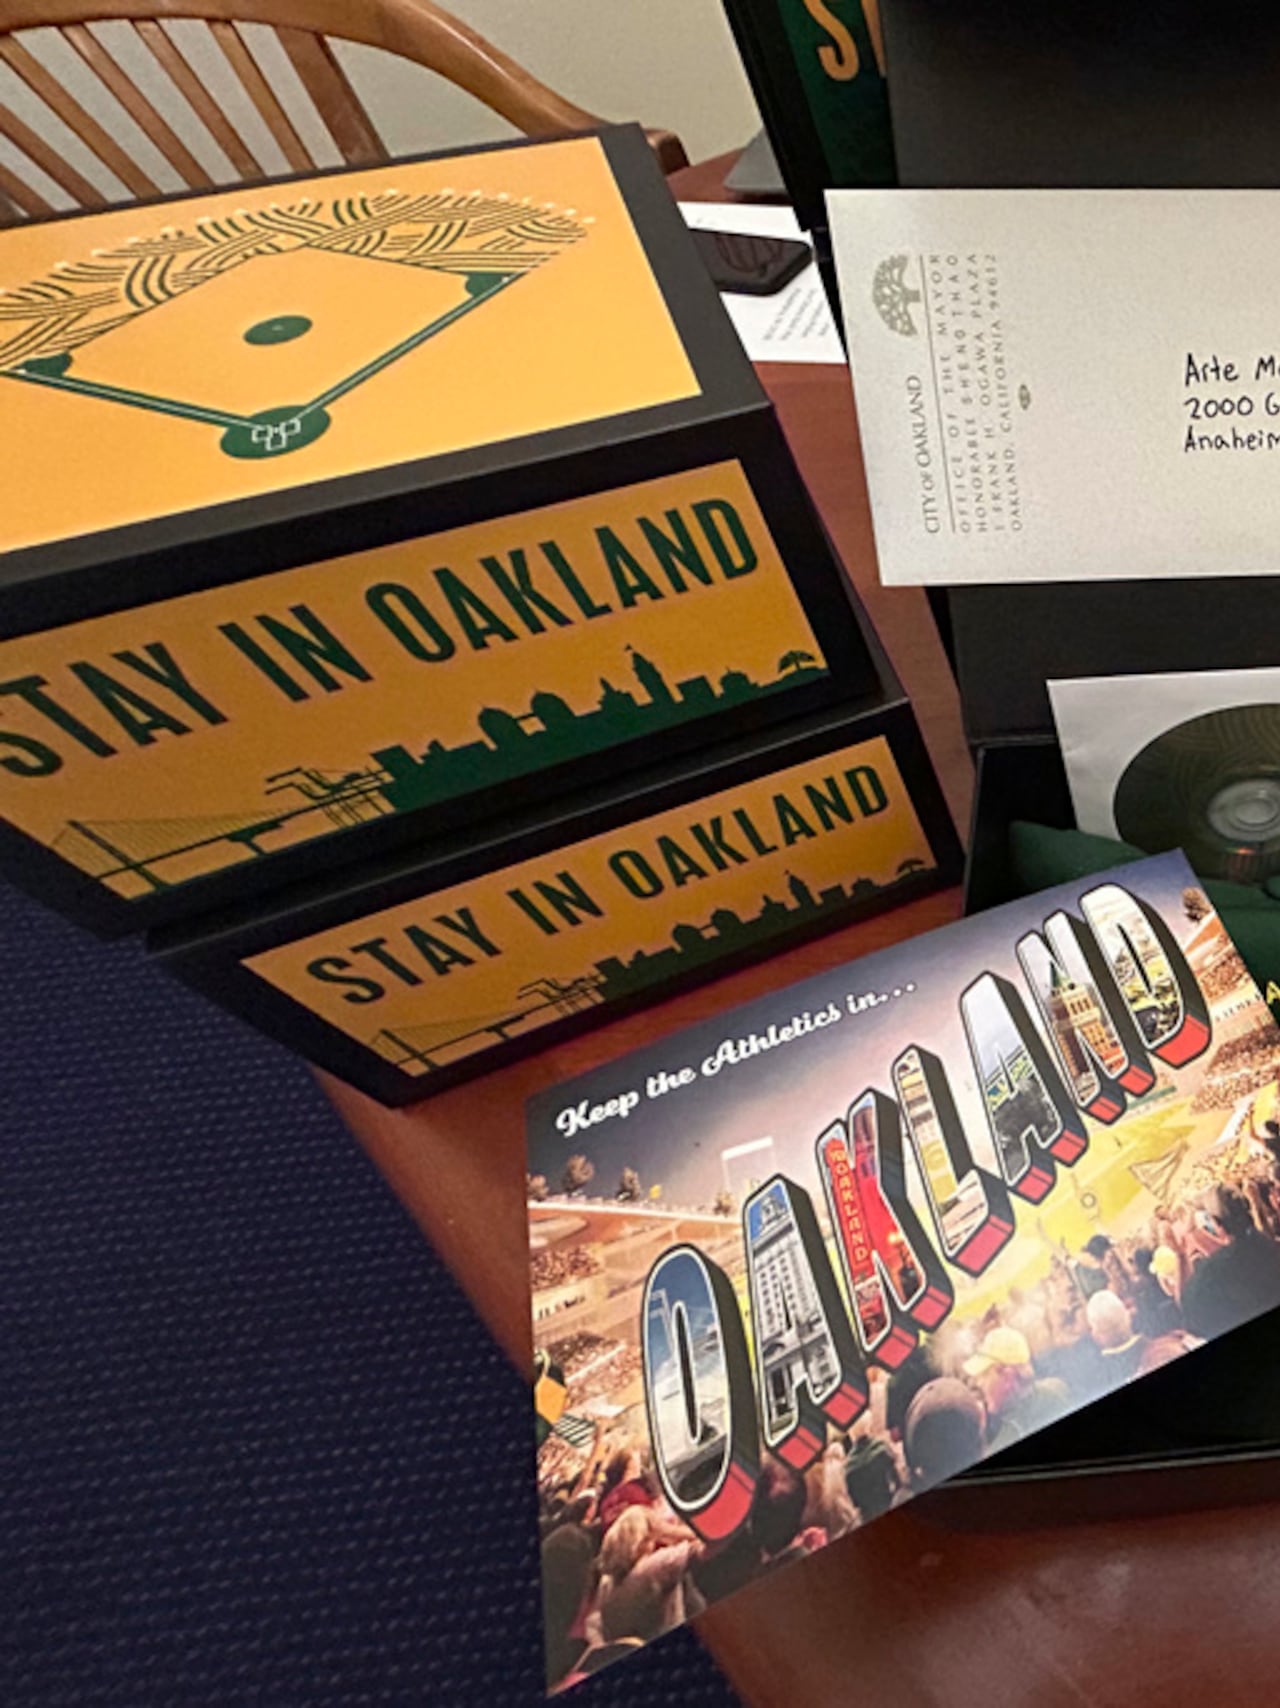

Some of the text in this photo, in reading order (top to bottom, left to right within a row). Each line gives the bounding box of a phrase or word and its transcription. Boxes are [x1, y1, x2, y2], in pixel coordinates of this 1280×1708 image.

[946, 255, 963, 317] THAO
[967, 254, 982, 318] PLAZA
[984, 254, 999, 310] 94612
[929, 255, 971, 533] OFFICE OF THE MAYOR
[974, 332, 991, 406] OGAWA
[991, 320, 1012, 433] CALIFORNIA
[1183, 395, 1254, 419] 2000
[1185, 353, 1239, 387] Arte
[906, 375, 941, 534] CITY OF OAKLAND
[965, 418, 988, 532] HONORABLE
[986, 451, 1003, 512] FRANK
[221, 602, 374, 704] IN
[365, 497, 762, 664] OAKLAND
[306, 763, 891, 1005] STAY IN OAKLAND
[556, 1090, 640, 1137] Keep
[646, 1072, 697, 1098] the
[701, 1003, 842, 1076] Athletics
[641, 881, 1213, 1543] OAKLAND
[835, 1162, 869, 1263] OAKLAND
